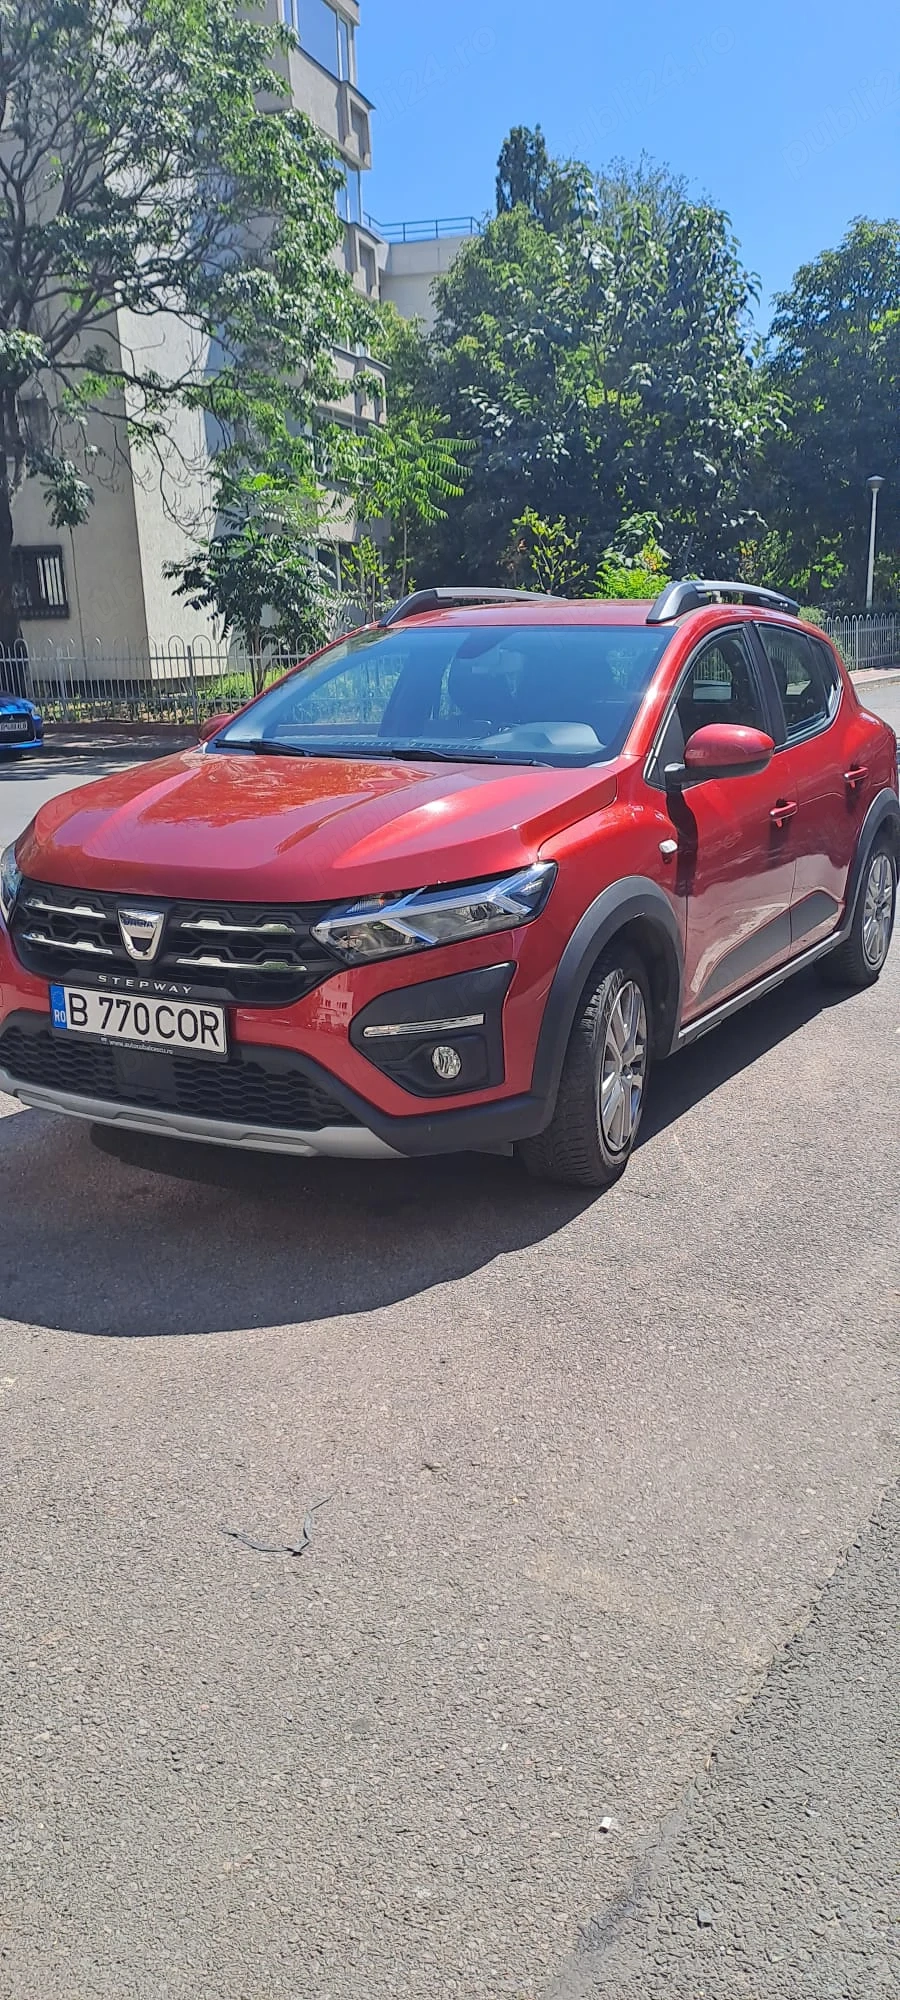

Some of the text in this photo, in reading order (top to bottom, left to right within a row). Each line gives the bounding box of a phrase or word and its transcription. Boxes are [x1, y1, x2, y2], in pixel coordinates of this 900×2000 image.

[98, 974, 193, 995] STEPWAY
[54, 1009, 67, 1024] RO
[68, 992, 88, 1027] B
